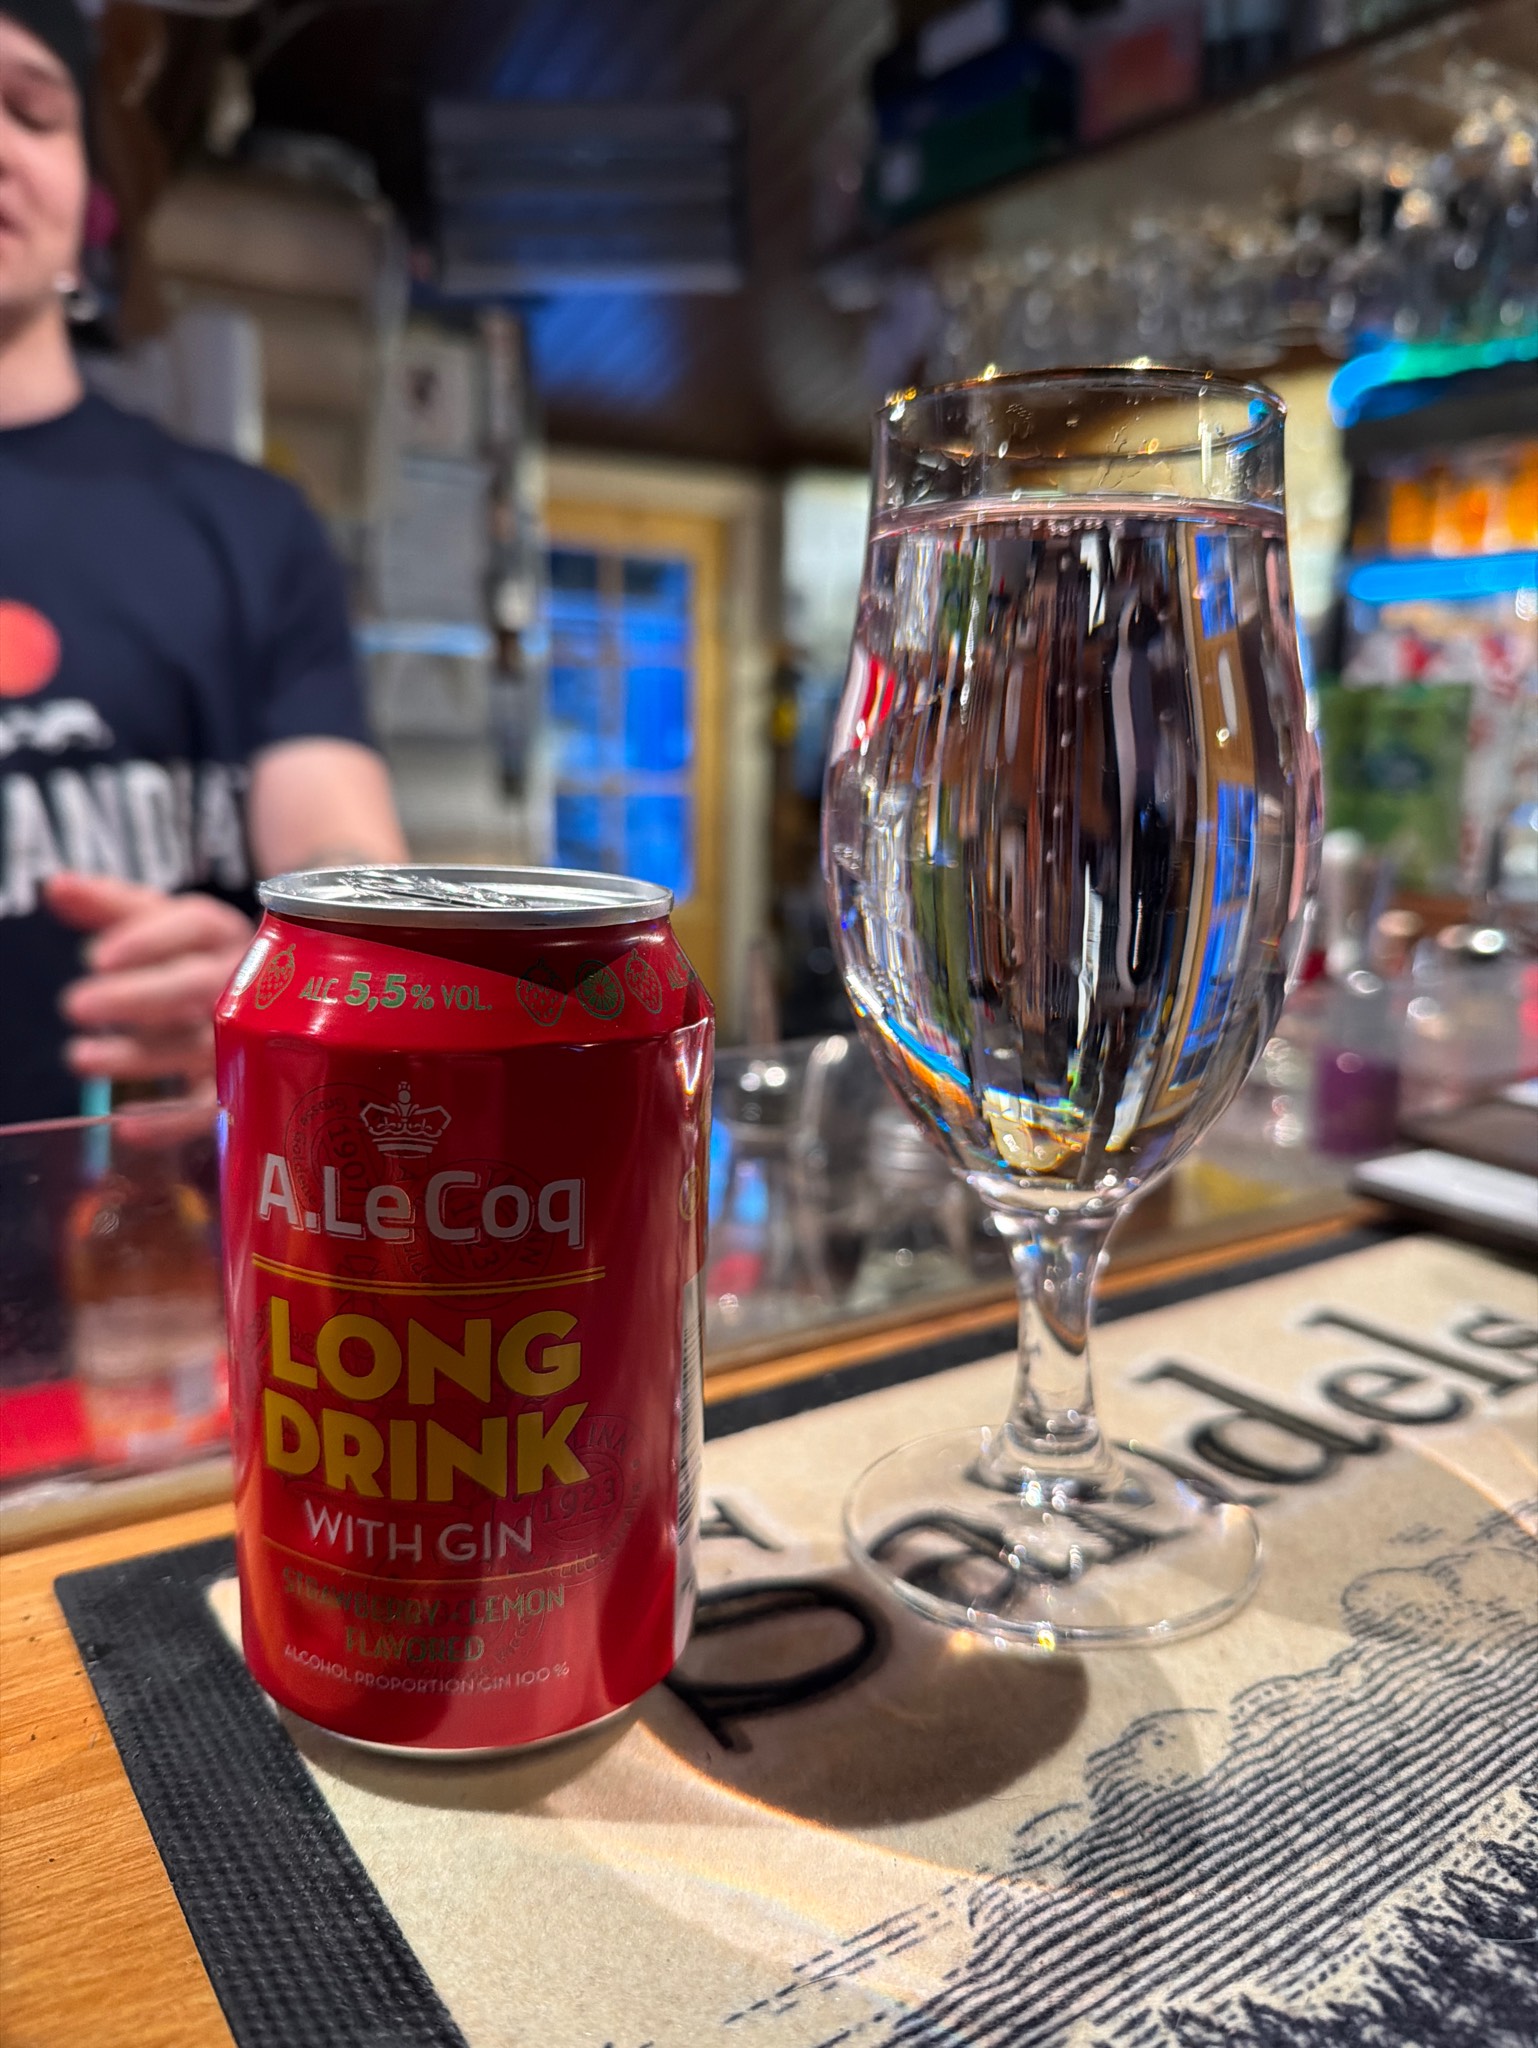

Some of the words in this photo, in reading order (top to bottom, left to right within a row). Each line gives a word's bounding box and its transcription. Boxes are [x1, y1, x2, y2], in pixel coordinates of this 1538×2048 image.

[298, 976, 340, 1004] ALC
[441, 984, 493, 1011] VOL.
[270, 1296, 582, 1405] LONG
[263, 1387, 590, 1502] DRINK
[304, 1499, 423, 1563] WITH
[437, 1516, 534, 1562] GIN
[469, 1583, 565, 1625] LEMON
[284, 1643, 352, 1682] ALCOHOL
[354, 1670, 475, 1694] PROPORTION
[478, 1674, 512, 1693] GIN
[345, 1626, 486, 1663] FLAVORED
